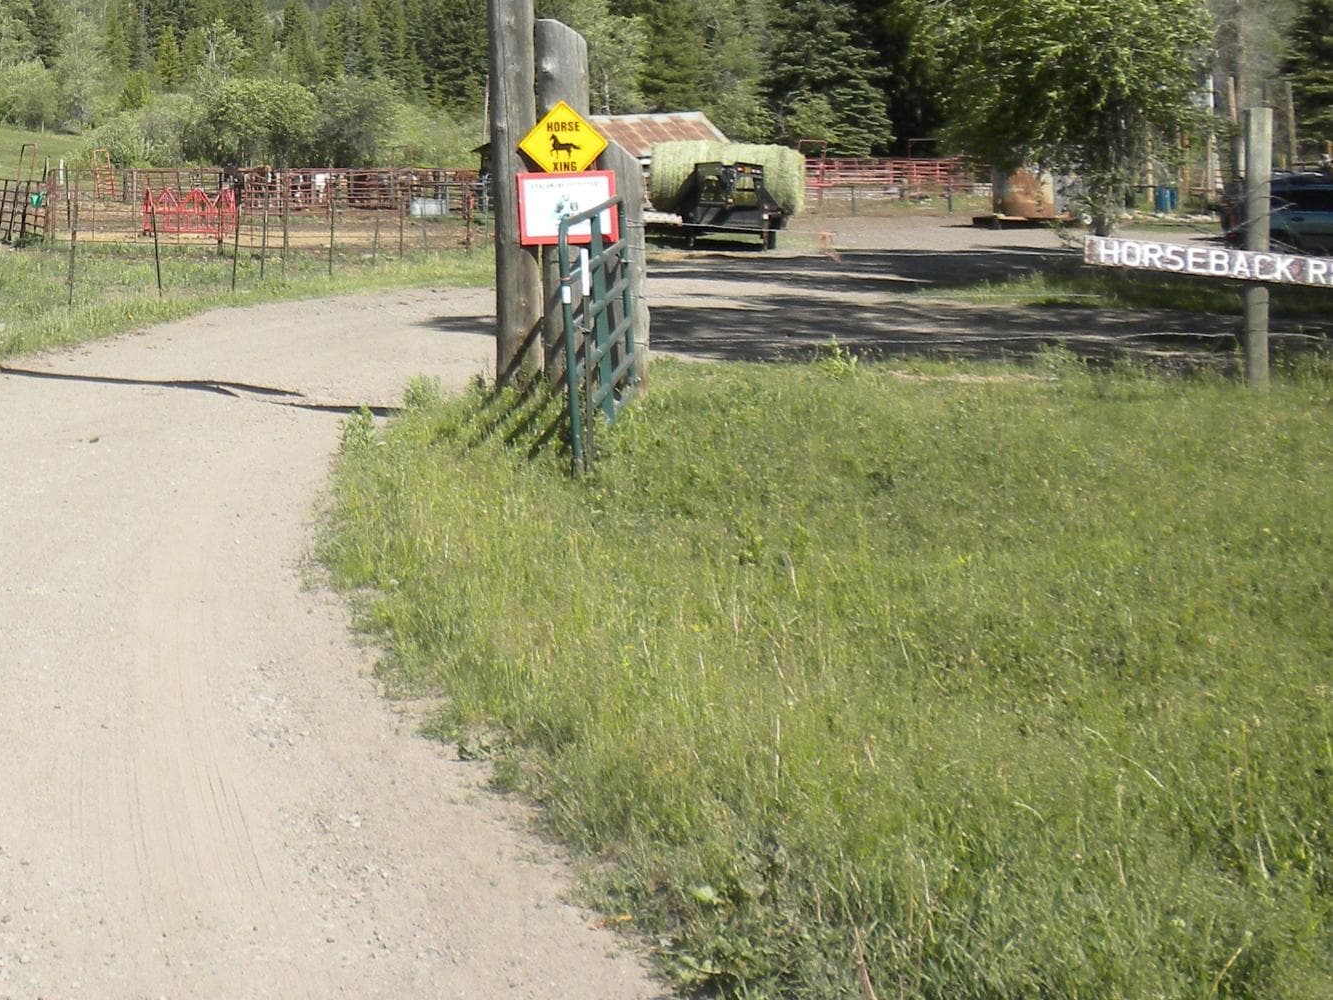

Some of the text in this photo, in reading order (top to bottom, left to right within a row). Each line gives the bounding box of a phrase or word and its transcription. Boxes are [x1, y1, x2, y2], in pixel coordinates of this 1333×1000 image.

[546, 121, 581, 132] HORSE
[552, 161, 577, 172] XING
[1099, 239, 1297, 282] HORSEBACK
